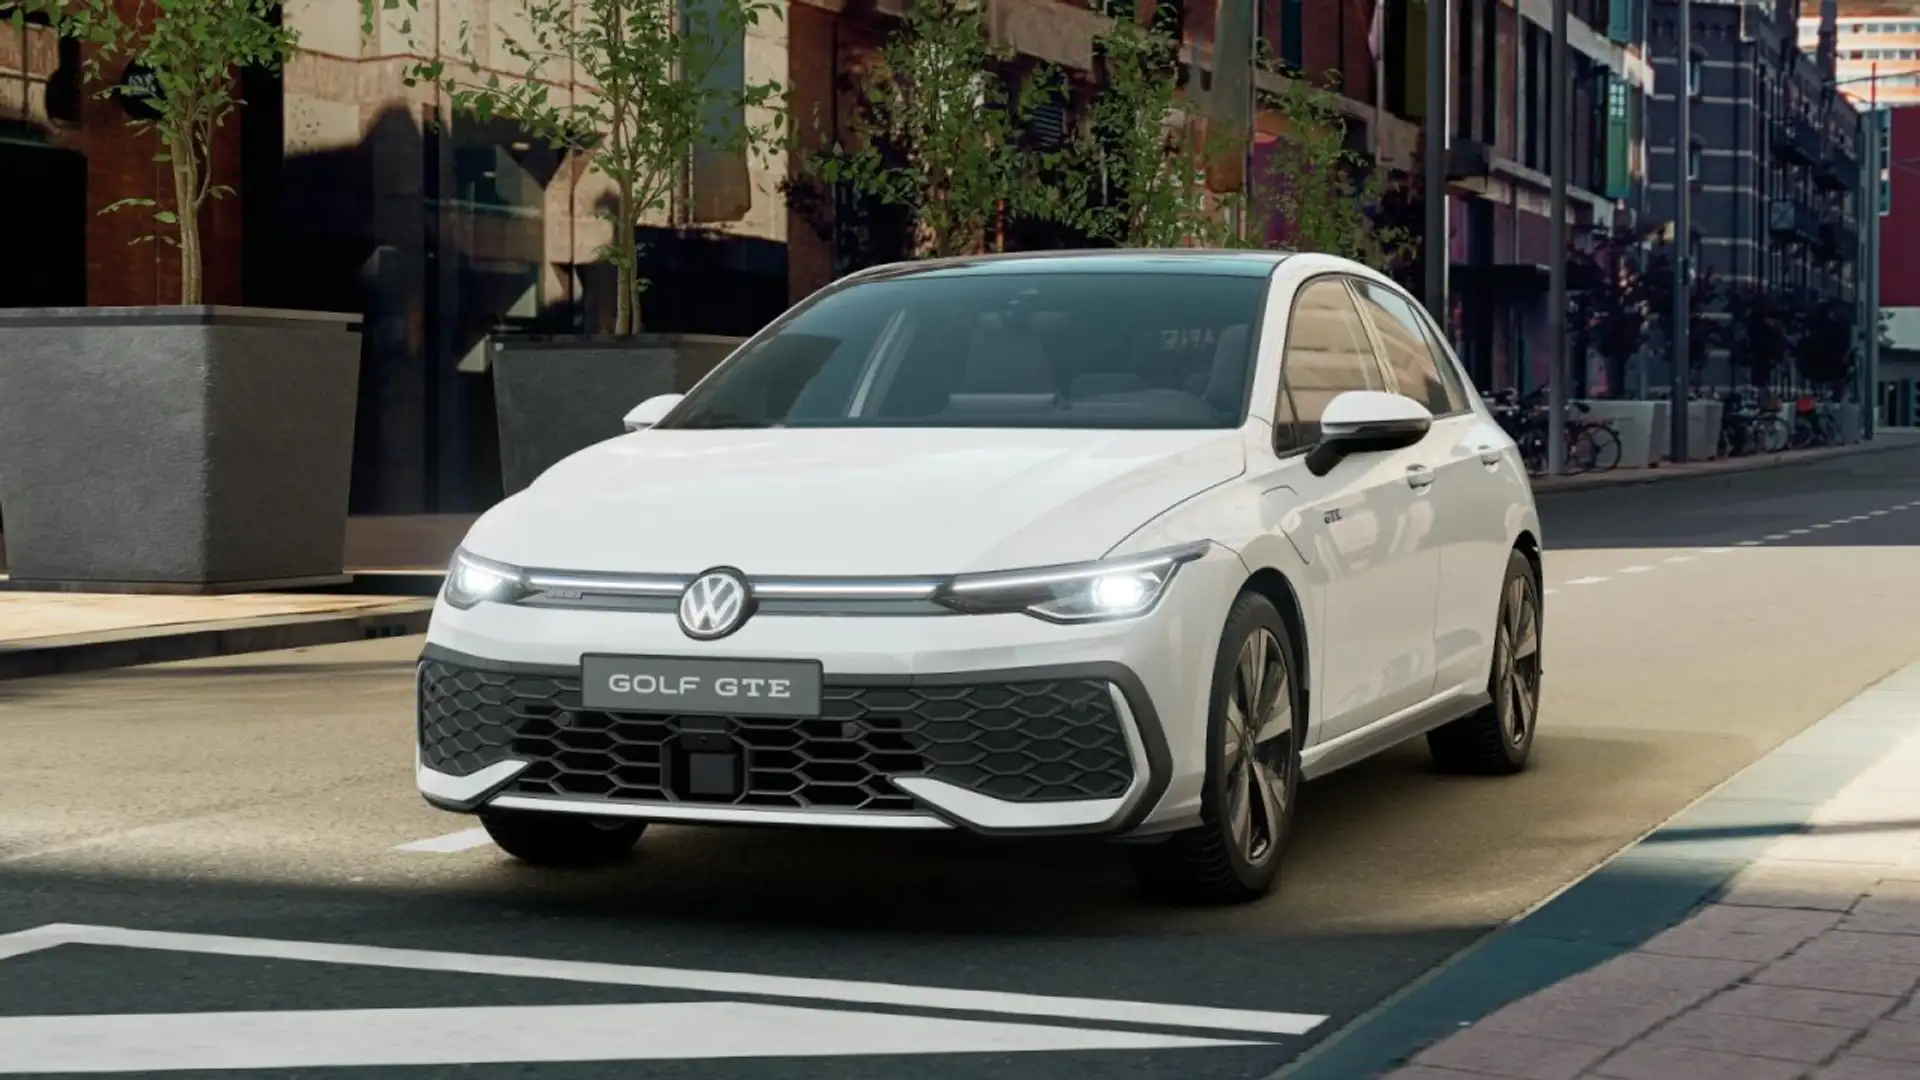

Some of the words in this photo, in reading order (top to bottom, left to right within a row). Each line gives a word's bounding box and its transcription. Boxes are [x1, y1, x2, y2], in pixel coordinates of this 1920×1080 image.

[680, 573, 745, 635] VW
[608, 674, 700, 695] GOLF
[714, 678, 791, 698] GTE
